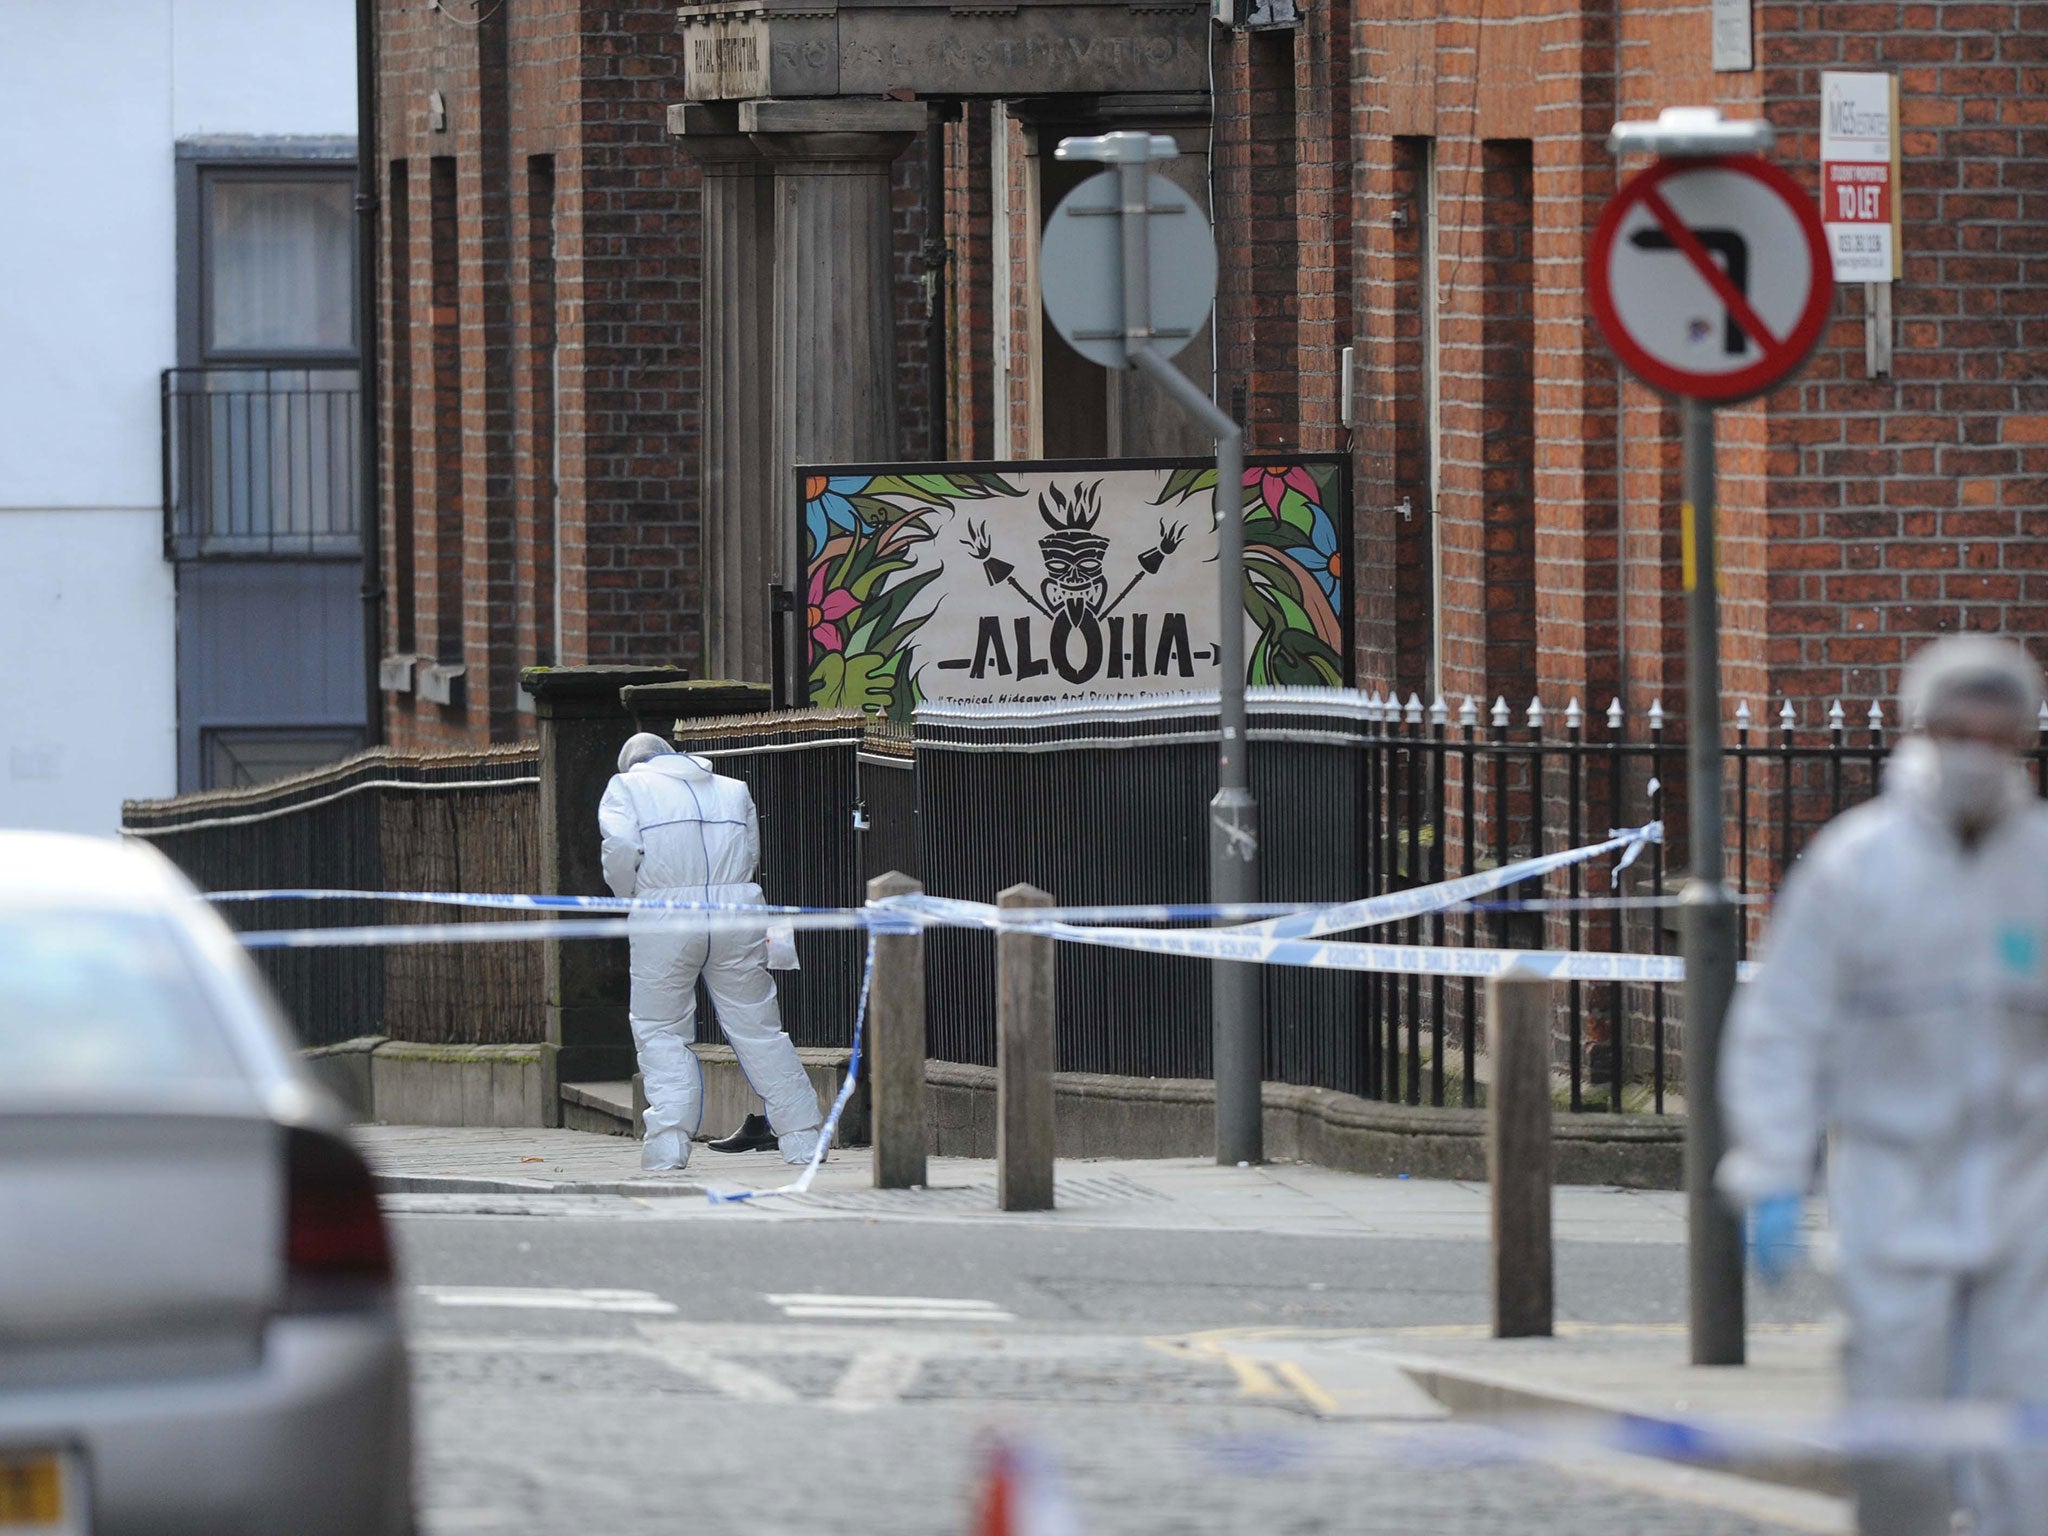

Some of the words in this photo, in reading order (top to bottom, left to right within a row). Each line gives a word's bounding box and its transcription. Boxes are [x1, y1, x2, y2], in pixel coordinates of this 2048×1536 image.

[1837, 185, 1856, 220] TO
[1857, 185, 1881, 220] LET
[970, 609, 1195, 685] ALOHA
[998, 693, 1057, 704] Hideaway
